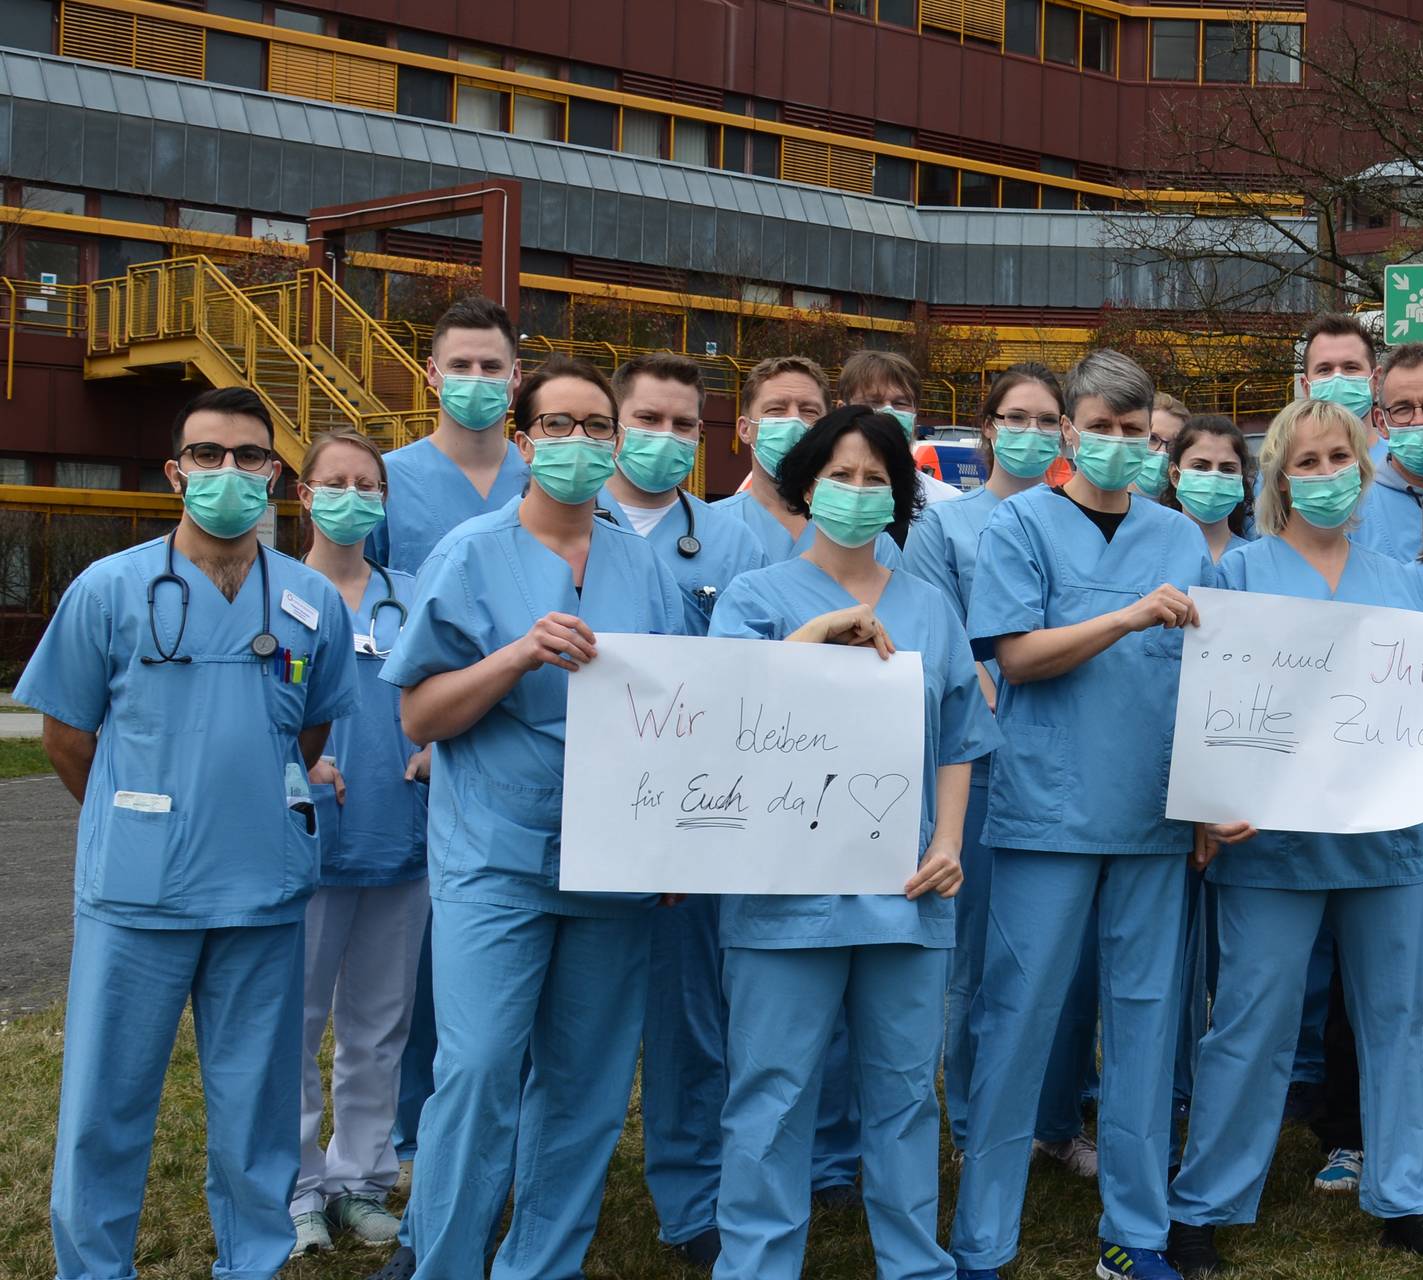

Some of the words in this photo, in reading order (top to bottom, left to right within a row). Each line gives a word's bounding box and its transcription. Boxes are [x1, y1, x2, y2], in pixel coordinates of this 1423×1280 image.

[626, 681, 705, 739] Wir
[735, 696, 839, 754] bleiben
[1204, 683, 1295, 735] bitte
[631, 771, 665, 820] für
[680, 773, 749, 813] Euch
